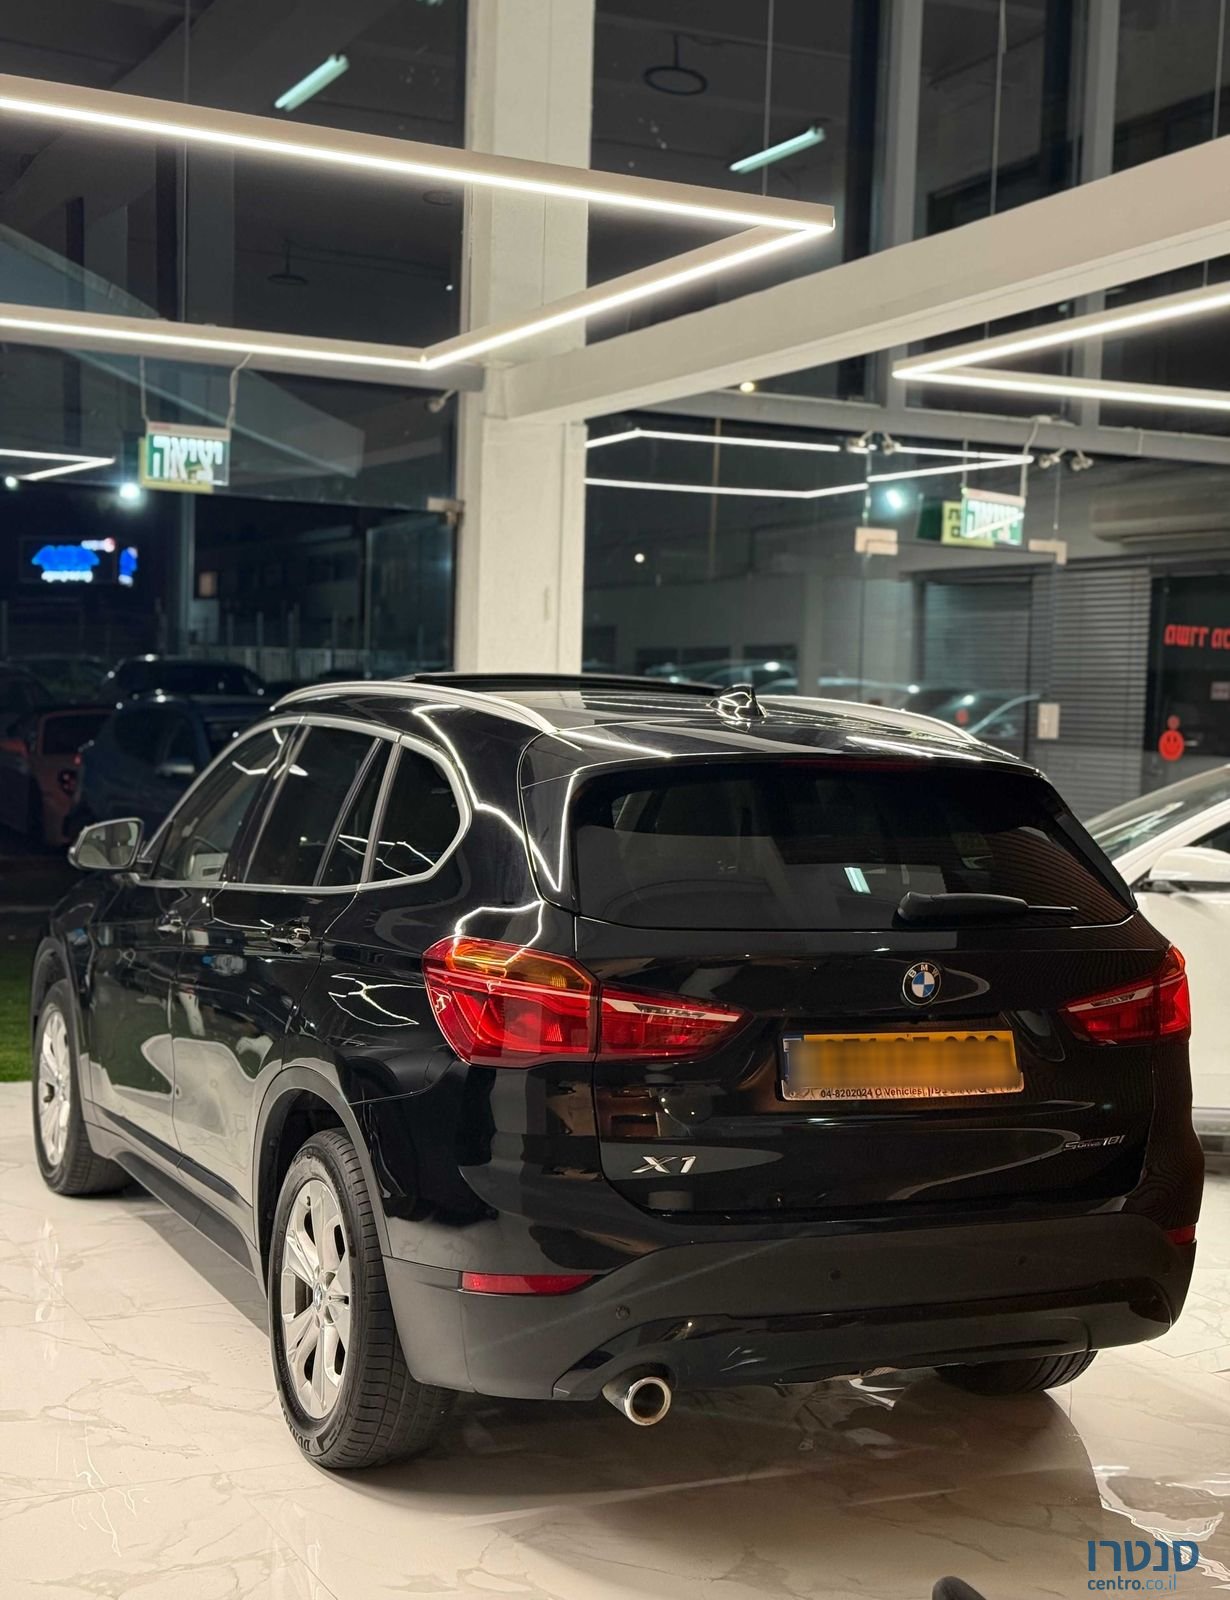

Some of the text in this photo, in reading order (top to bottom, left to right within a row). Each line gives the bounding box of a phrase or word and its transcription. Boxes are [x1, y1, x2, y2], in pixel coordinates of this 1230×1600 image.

[153, 435, 223, 482] יציאה
[908, 964, 940, 978] BMW
[631, 1156, 697, 1173] X1
